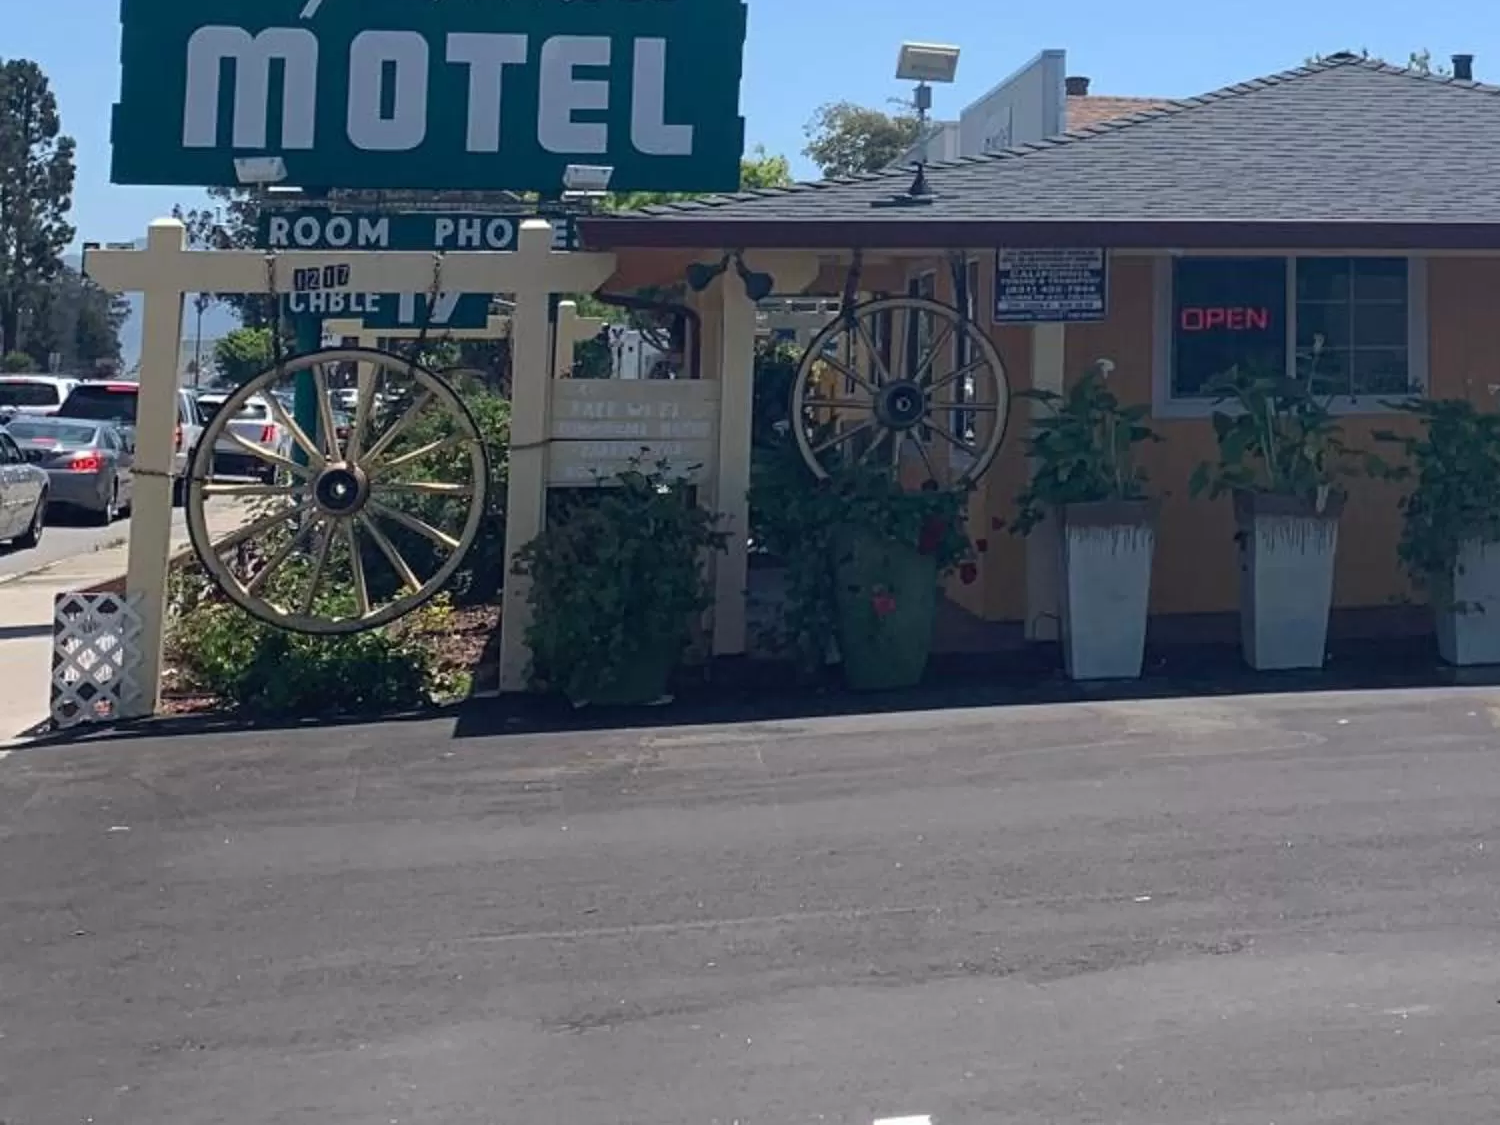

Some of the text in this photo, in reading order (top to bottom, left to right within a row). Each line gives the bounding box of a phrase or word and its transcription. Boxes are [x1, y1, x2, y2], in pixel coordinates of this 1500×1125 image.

[182, 25, 694, 156] MOTEL
[269, 216, 580, 248] ROOM PHOE
[294, 264, 350, 291] 1217
[1181, 307, 1268, 330] OPEN
